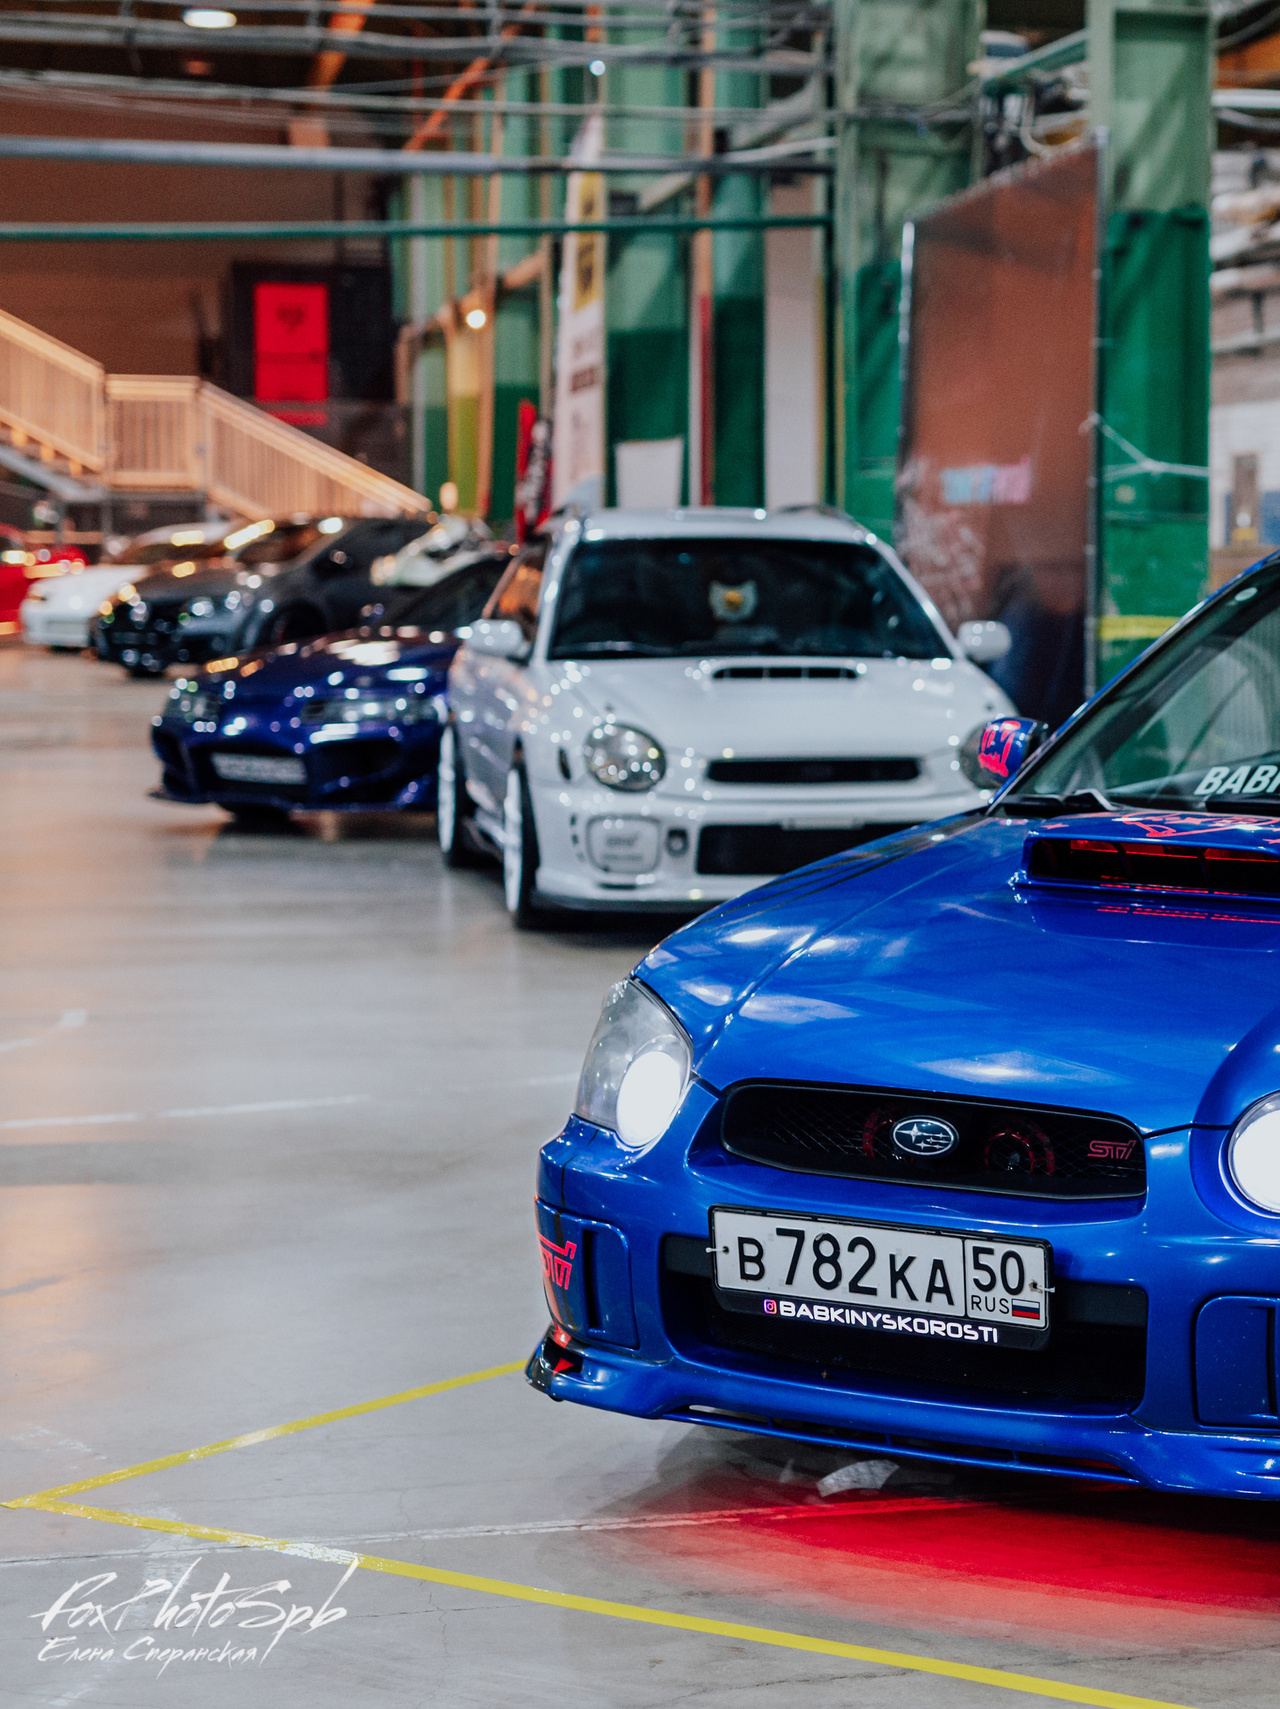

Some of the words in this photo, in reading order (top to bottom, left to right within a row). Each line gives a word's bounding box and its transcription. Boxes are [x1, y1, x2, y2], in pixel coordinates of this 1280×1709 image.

[971, 1246, 1026, 1296] 50
[779, 1300, 998, 1343] BABKINYSKOROSTI
[971, 1295, 1010, 1315] RUS
